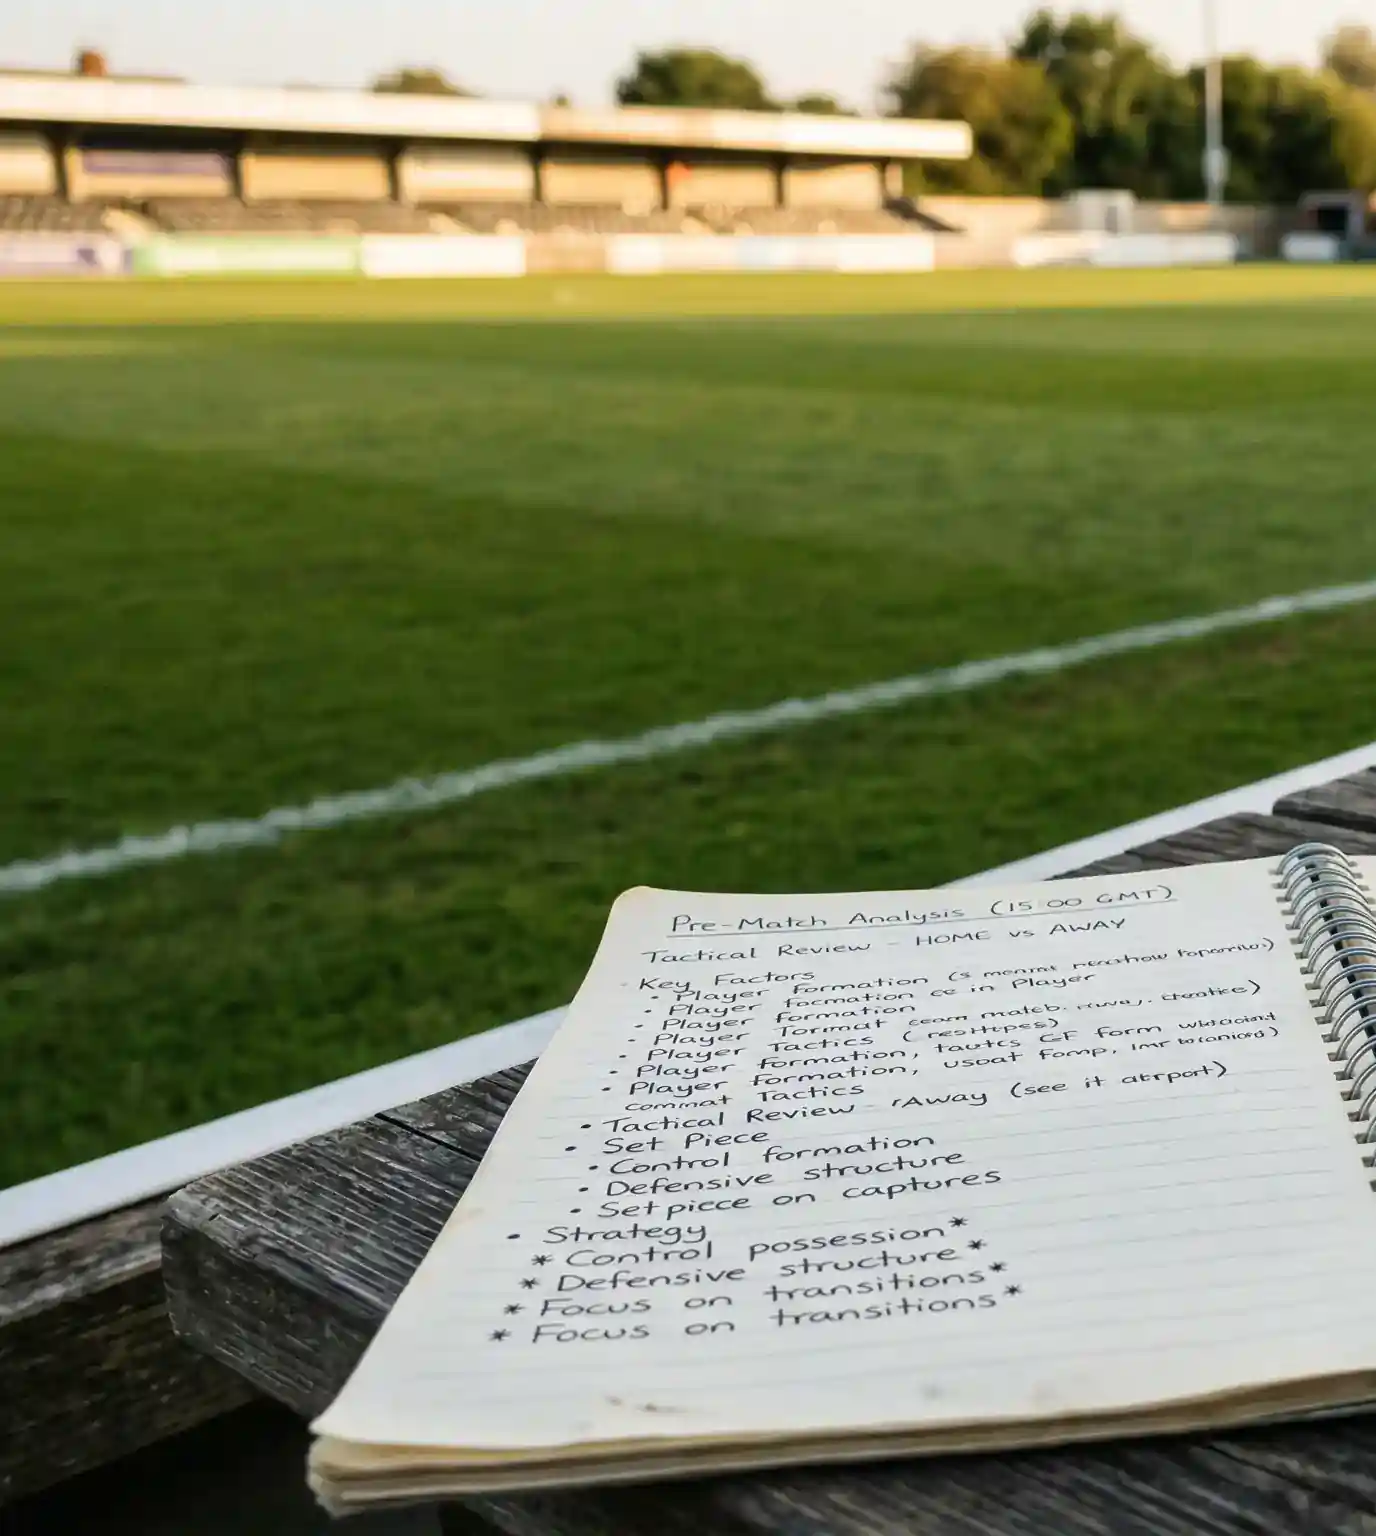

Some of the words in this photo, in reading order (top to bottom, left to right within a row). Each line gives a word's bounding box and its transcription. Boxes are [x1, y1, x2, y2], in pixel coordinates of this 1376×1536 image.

[672, 914, 827, 932] Pre-Match
[848, 909, 965, 926] Analysis
[1097, 885, 1173, 903] GMT)
[641, 948, 757, 964] Tactical
[778, 943, 872, 957] Review
[916, 930, 991, 946] HOME
[1009, 929, 1035, 938] vs
[1049, 918, 1126, 935] AWAY
[639, 977, 691, 993] Key
[714, 970, 816, 985] Factors
[669, 1003, 762, 1018] Player
[970, 984, 995, 993] in
[1011, 973, 1096, 989] Player
[676, 989, 770, 1003] Player
[653, 1032, 750, 1047] Player
[662, 1017, 754, 1033] Player
[636, 1063, 737, 1080] Player
[1094, 1025, 1162, 1039] form
[647, 1048, 747, 1063] Player
[768, 1036, 875, 1053] Tactics
[602, 1111, 724, 1133] Tactical
[747, 1104, 855, 1122] Review
[1010, 1082, 1068, 1098] (see
[1085, 1073, 1106, 1089] it
[629, 1080, 729, 1098] Player
[757, 1084, 865, 1103] Tactics
[602, 1137, 664, 1154] Set
[684, 1129, 769, 1150] Piece
[609, 1152, 730, 1175] Control
[763, 1135, 935, 1163] formation
[606, 1171, 774, 1197] Defensive
[803, 1151, 966, 1182] structure
[772, 1193, 816, 1206] on
[842, 1170, 1002, 1200] captures
[542, 1222, 707, 1245] Strategy
[566, 1241, 712, 1267] Control
[749, 1226, 945, 1261] possession
[557, 1267, 746, 1292] Defensive
[780, 1247, 961, 1277] structure
[540, 1298, 652, 1317] Focus
[684, 1296, 733, 1309] on
[763, 1271, 985, 1302] transitions
[531, 1323, 650, 1344] Focus
[684, 1321, 736, 1336] on
[769, 1294, 997, 1327] transitions
